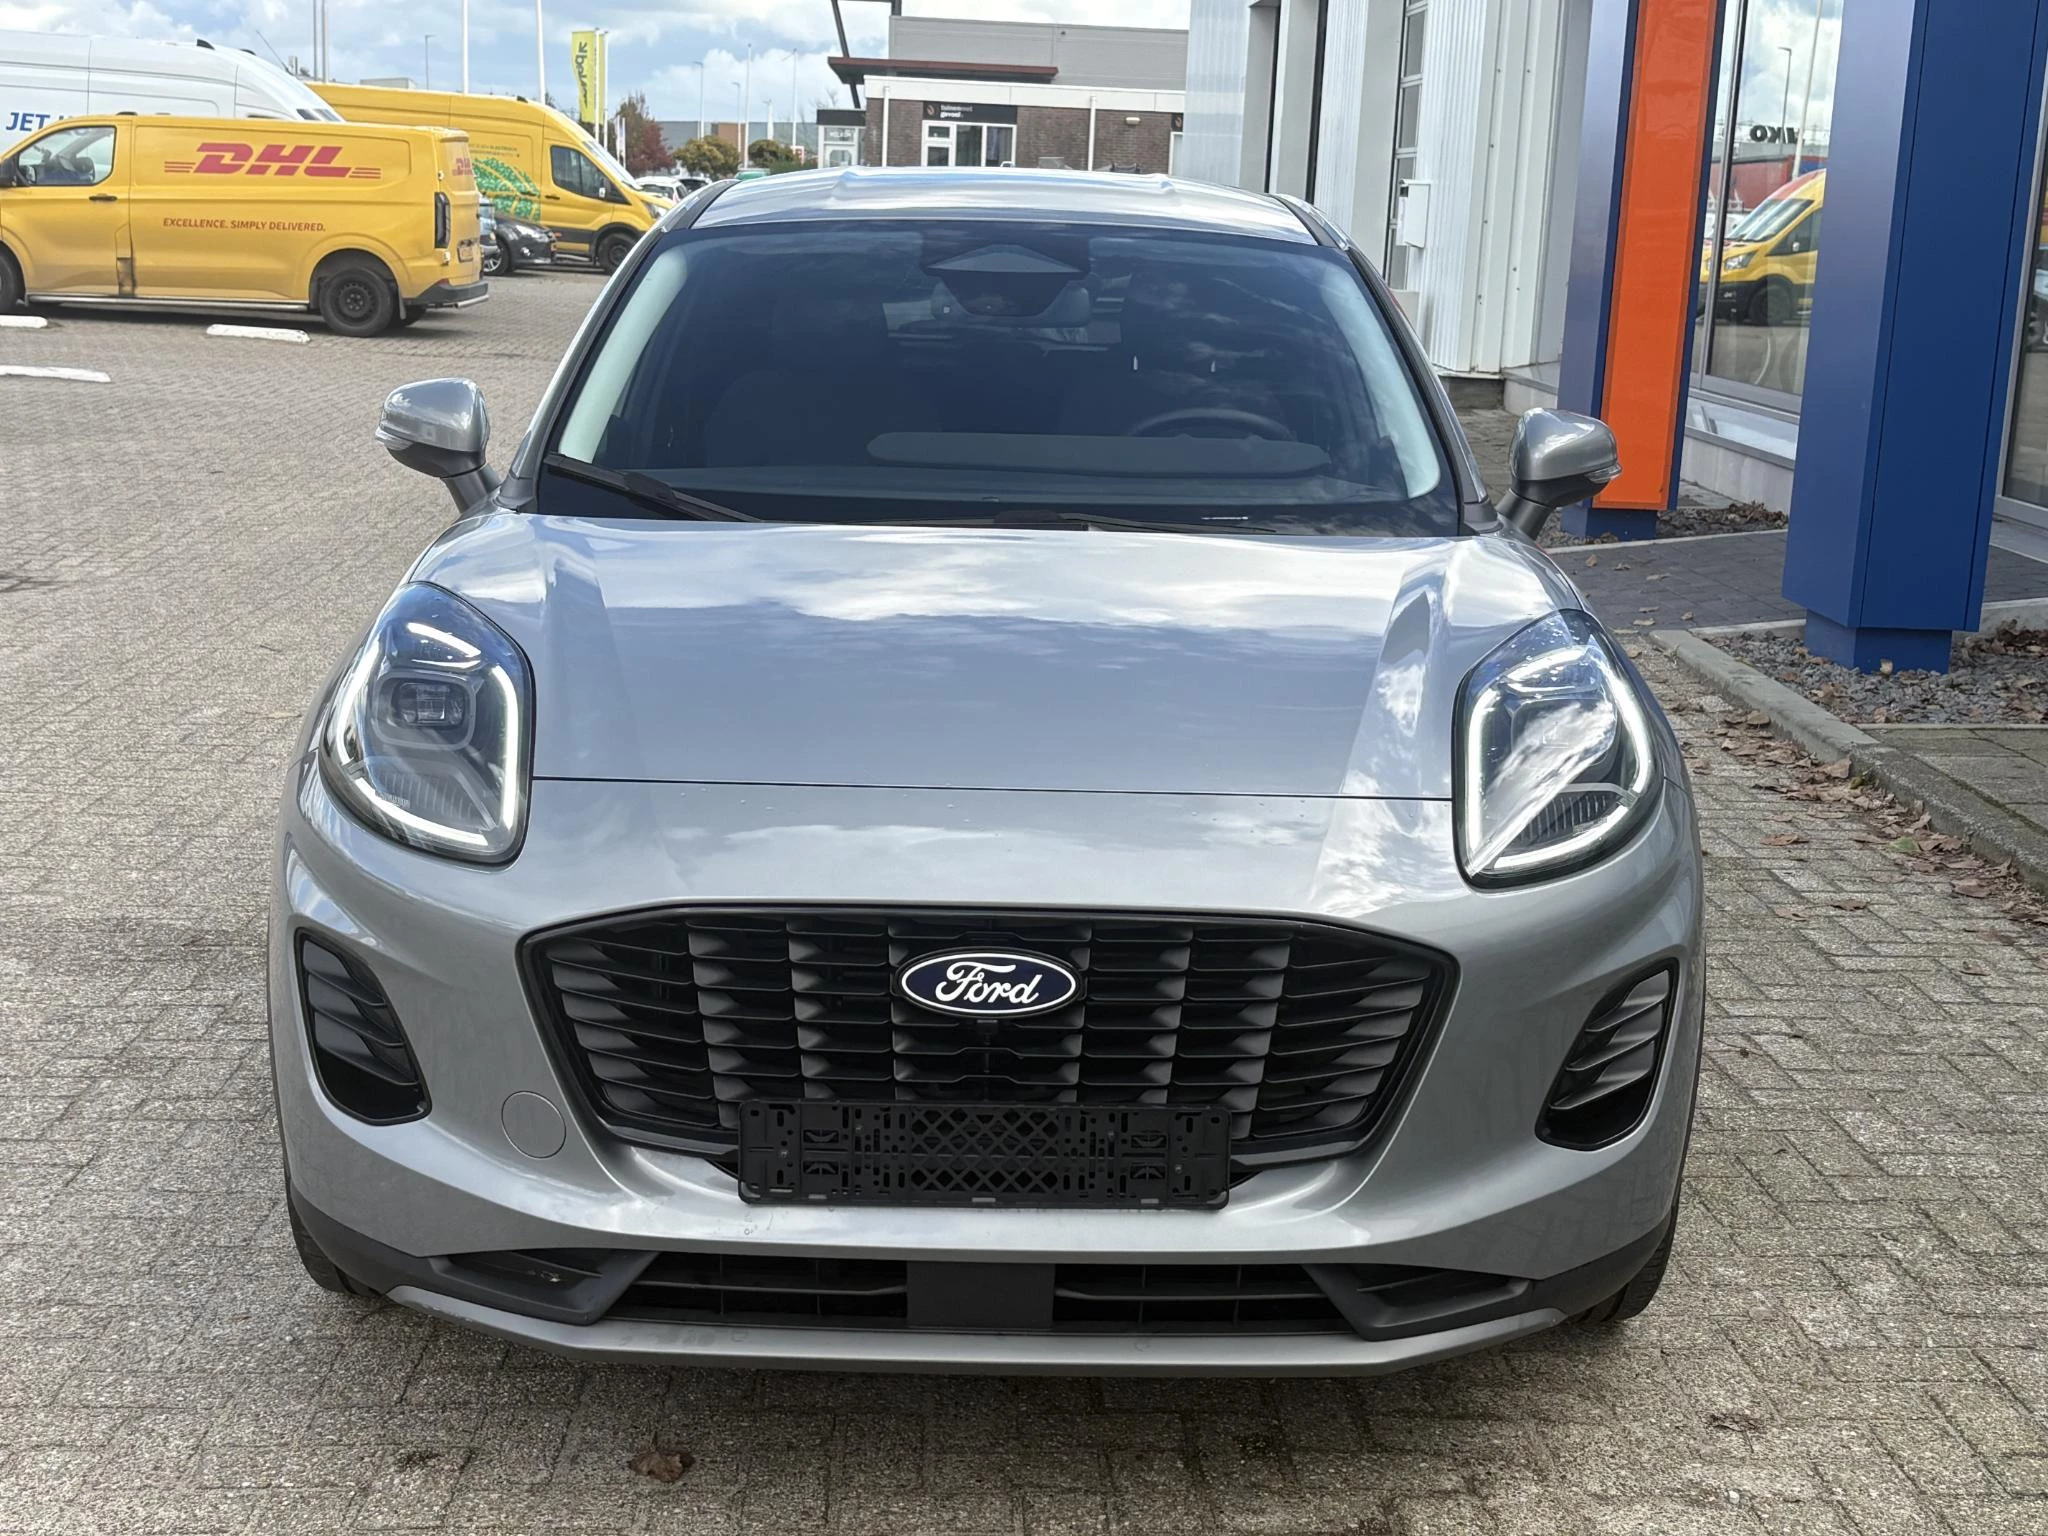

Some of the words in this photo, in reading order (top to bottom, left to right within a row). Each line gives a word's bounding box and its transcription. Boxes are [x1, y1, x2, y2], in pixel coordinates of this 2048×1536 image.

[5, 112, 50, 132] JET
[196, 142, 352, 178] DHL
[163, 217, 228, 229] EXCELLENCE.
[230, 219, 267, 230] SIMPLY
[268, 221, 326, 232] DELIVERED.
[935, 961, 1043, 1004] Ford
